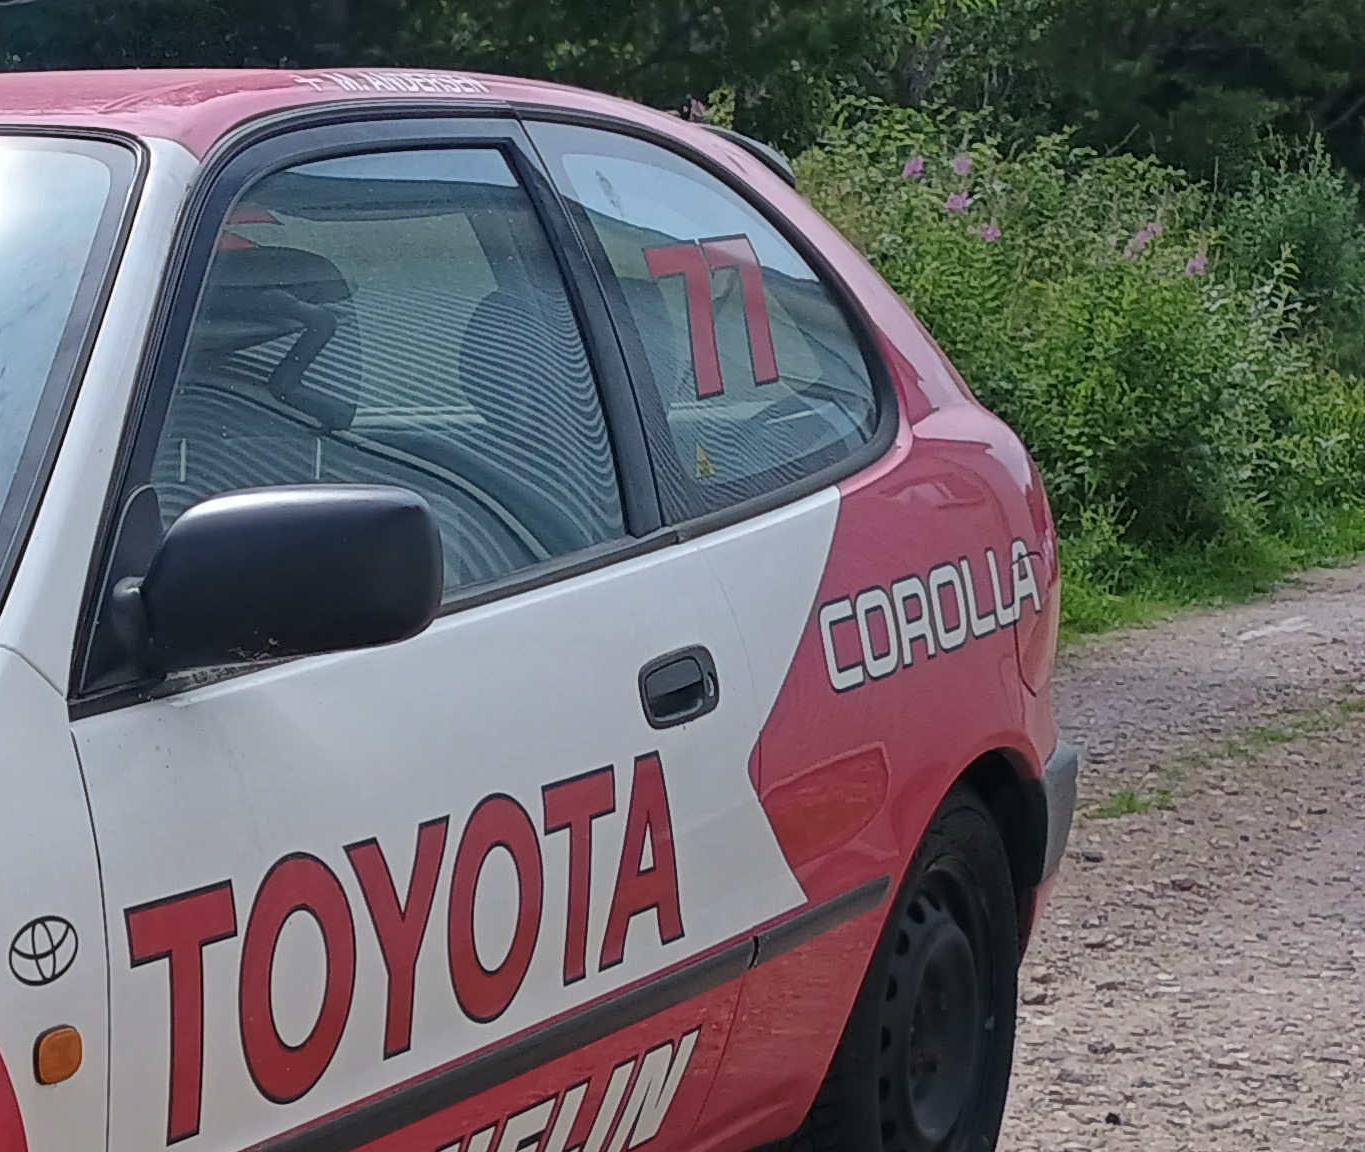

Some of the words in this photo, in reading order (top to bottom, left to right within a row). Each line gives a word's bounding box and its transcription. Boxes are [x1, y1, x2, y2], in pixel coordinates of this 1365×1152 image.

[643, 233, 779, 400] 77
[818, 537, 1042, 694] COROLLA
[123, 750, 686, 1147] TOYOTA
